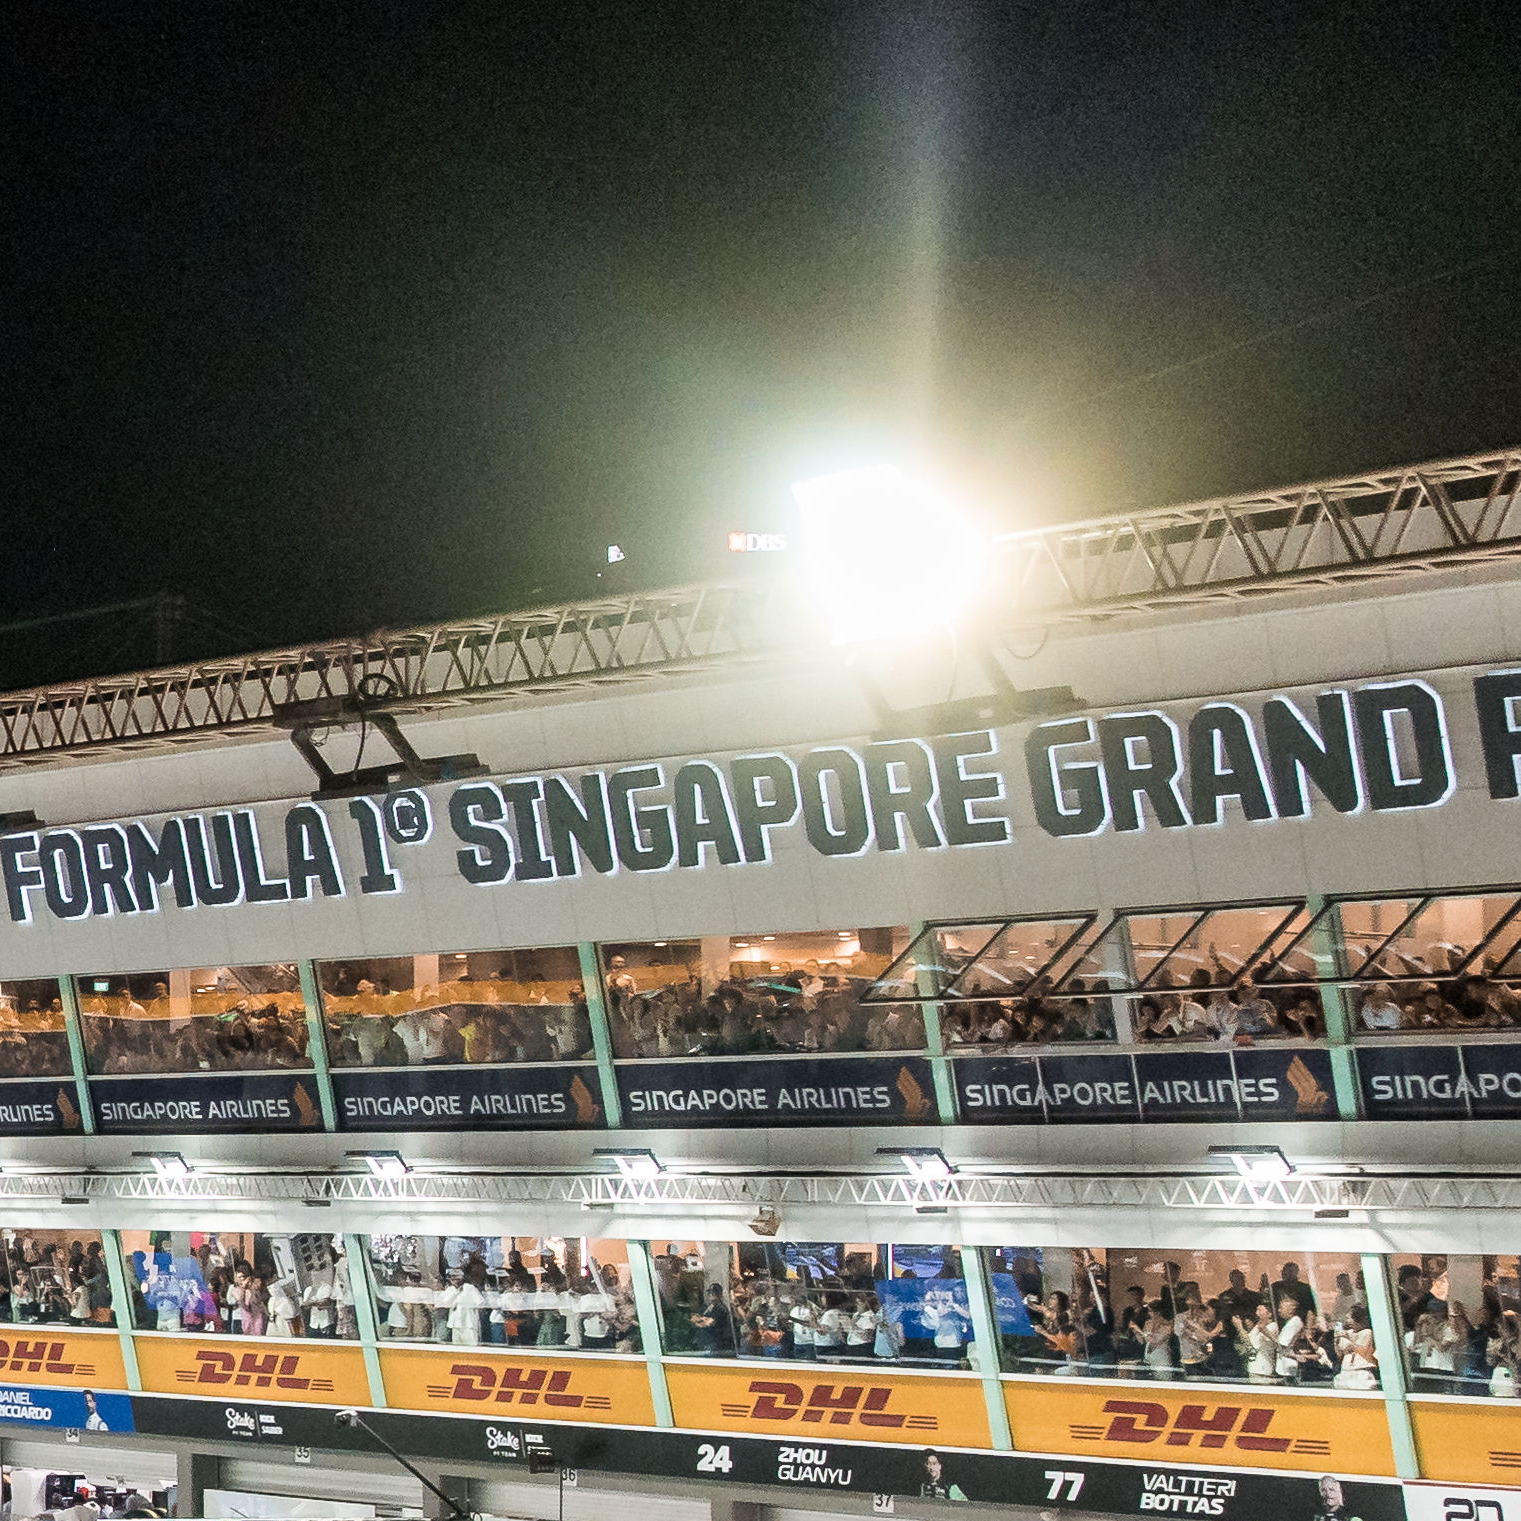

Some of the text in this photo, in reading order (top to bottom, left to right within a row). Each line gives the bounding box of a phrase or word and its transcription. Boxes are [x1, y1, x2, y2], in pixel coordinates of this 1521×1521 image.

[449, 730, 1014, 886] SINGAPORE
[1024, 678, 1458, 839] GRAND
[344, 1093, 566, 1117] SINGAPORE AIRLINES
[629, 1086, 891, 1113] SINGAPORE AIRLINES
[965, 1077, 1280, 1108] SINGAPORE AIRLINES
[100, 1099, 291, 1122] SINGAPORE AIRLINES
[195, 1350, 311, 1390] DHL
[450, 1364, 584, 1408] DHL
[748, 1381, 907, 1428] DHL
[225, 1407, 255, 1430] Stake
[1102, 1400, 1293, 1454] DHL
[485, 1426, 520, 1450] Stake
[696, 1443, 733, 1474] 24
[777, 1446, 827, 1465] ZHOU
[777, 1466, 852, 1486] GUANYU
[1043, 1469, 1086, 1501] 77
[1140, 1473, 1237, 1497] VALTTERI
[1139, 1492, 1225, 1516] BOTTAS
